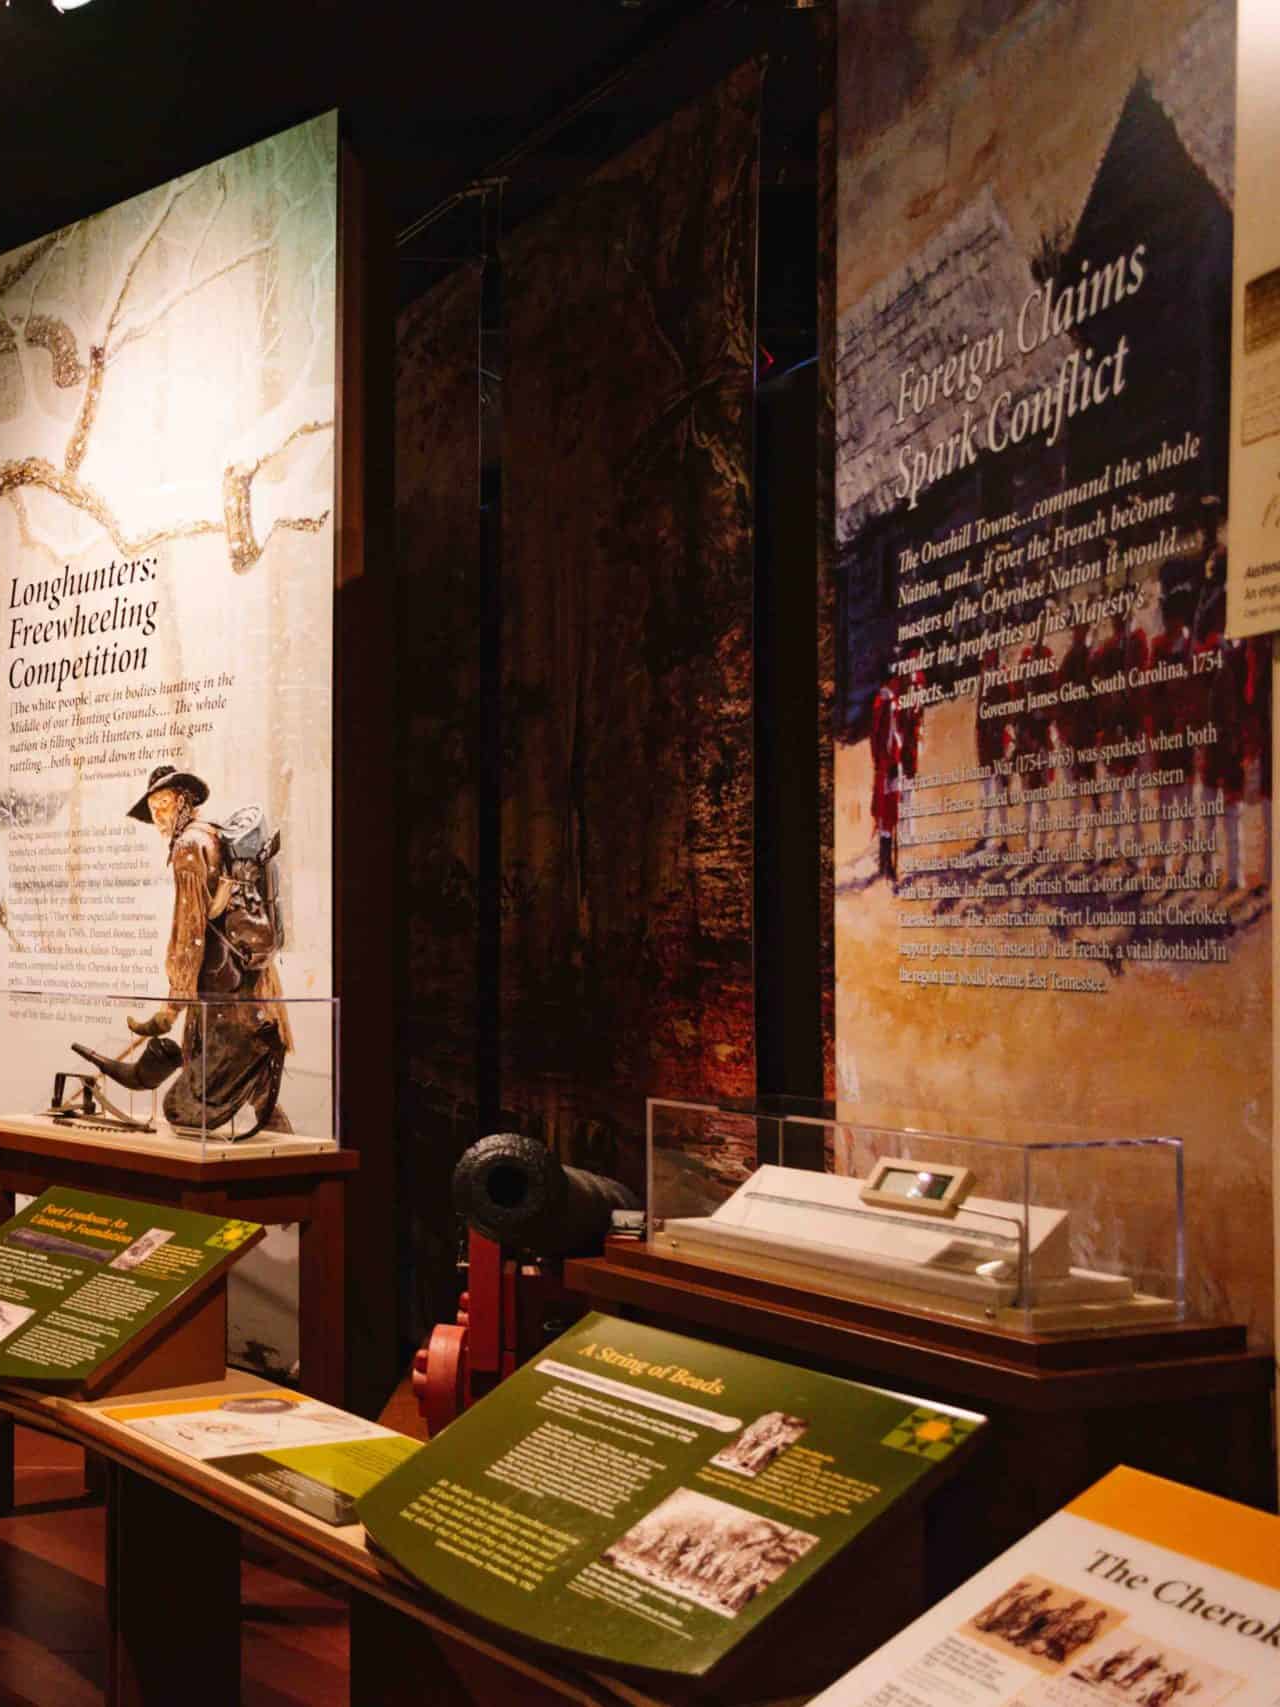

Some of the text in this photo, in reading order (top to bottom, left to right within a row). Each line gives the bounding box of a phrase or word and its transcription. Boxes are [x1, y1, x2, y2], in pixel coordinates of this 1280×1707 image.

[895, 244, 1146, 425] Foreign Claims
[894, 335, 1130, 511] Spark Conflict
[898, 549, 919, 574] The
[921, 522, 972, 564] Overhill
[1114, 457, 1142, 489] the
[1146, 431, 1201, 476] whole
[994, 546, 1024, 574] ever
[1026, 532, 1051, 561] the
[1053, 509, 1107, 552] French
[1110, 491, 1176, 532] become
[8, 557, 159, 611] Longhunters:
[897, 613, 942, 642] masters
[943, 600, 958, 632] of
[958, 597, 978, 623] the
[981, 576, 1045, 615] Cherokee
[1048, 559, 1101, 594] Nation
[8, 597, 160, 649] Freewheeling
[897, 650, 936, 677] render
[937, 640, 955, 664] the
[959, 622, 1024, 666] properties
[1027, 609, 1044, 646] of
[1045, 608, 1067, 634] his
[8, 642, 148, 692] Competition
[980, 649, 1224, 720] Governor James Glen, South Carolina, 1754
[982, 655, 1060, 697] precarious.
[31, 696, 56, 712] white
[94, 693, 110, 705] are
[112, 689, 123, 701] in
[124, 684, 157, 701] bodies
[159, 676, 201, 697] hunting
[203, 674, 215, 689] in
[217, 672, 236, 688] the
[10, 719, 40, 736] Middle
[42, 715, 53, 733] of
[53, 718, 68, 729] our
[72, 711, 111, 729] Hunting
[175, 698, 193, 714] The
[195, 693, 228, 711] whole
[9, 740, 38, 753] nation
[40, 738, 48, 750] is
[48, 735, 77, 754] filling
[78, 730, 99, 746] with
[146, 722, 167, 739] and
[169, 720, 185, 736] the
[185, 722, 214, 738] guns
[73, 755, 86, 771] up
[87, 748, 107, 765] and
[108, 748, 136, 764] down
[138, 746, 155, 761] the
[1099, 732, 1147, 766] sparked
[1148, 728, 1185, 753] when
[1185, 720, 1218, 748] both
[1123, 767, 1138, 790] of
[1139, 768, 1185, 788] eastern
[1162, 797, 1194, 820] trade
[1198, 788, 1225, 816] and
[1120, 836, 1180, 858] Cherokee
[1181, 830, 1216, 853] sided
[1063, 874, 1090, 893] built
[1141, 873, 1160, 890] the
[1165, 868, 1201, 889] midst
[1204, 865, 1219, 888] of
[1085, 904, 1136, 926] Loudoun
[1139, 904, 1163, 926] and
[1165, 902, 1228, 927] Cherokee
[1072, 938, 1114, 961] French,
[1125, 938, 1152, 959] vital
[1153, 938, 1209, 961] foothold
[1213, 939, 1228, 961] in
[579, 1343, 594, 1357] A
[596, 1346, 644, 1376] String
[647, 1362, 673, 1381] of
[669, 1366, 726, 1396] Beads
[1083, 1549, 1149, 1592] The
